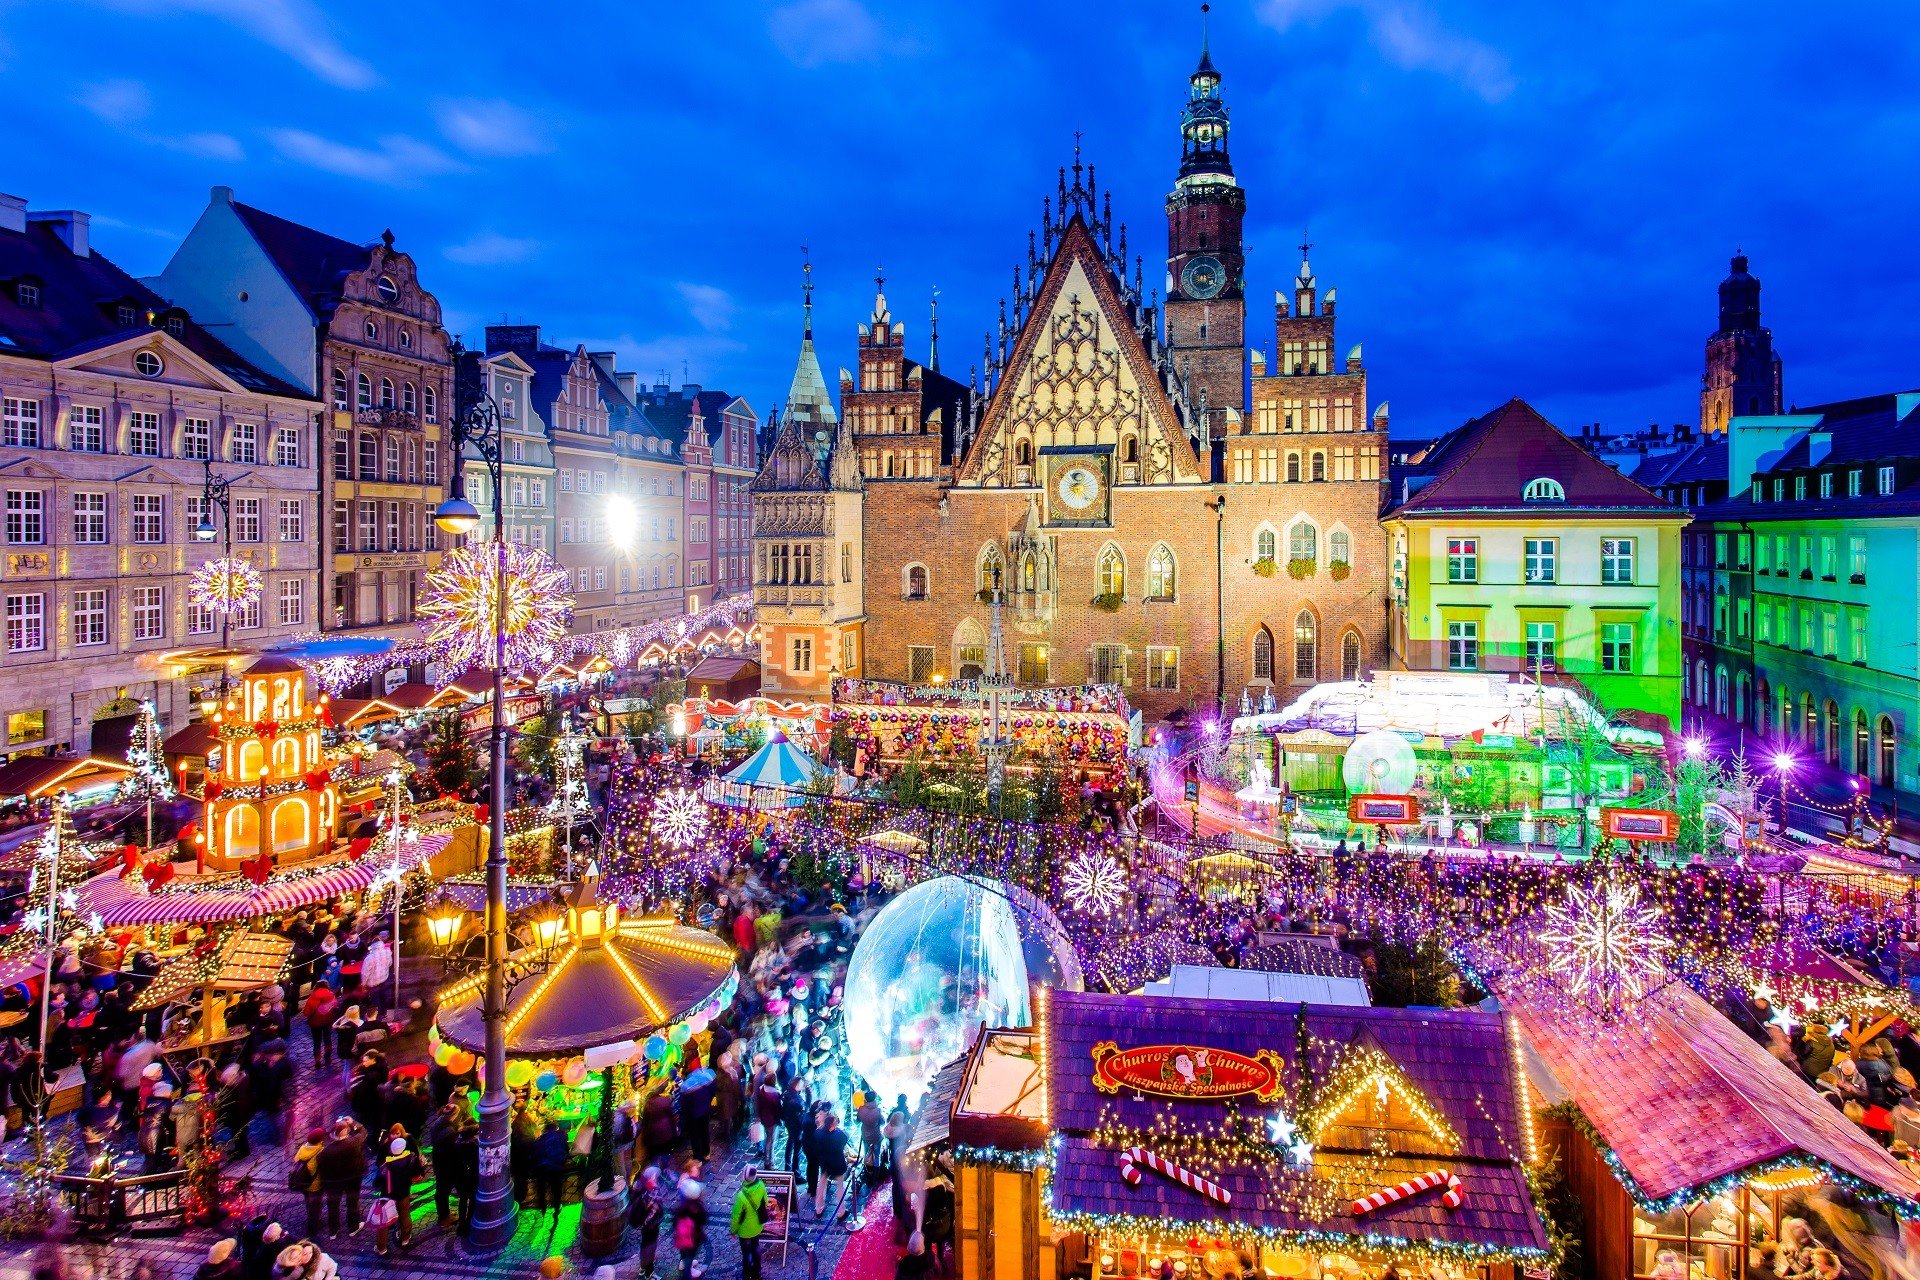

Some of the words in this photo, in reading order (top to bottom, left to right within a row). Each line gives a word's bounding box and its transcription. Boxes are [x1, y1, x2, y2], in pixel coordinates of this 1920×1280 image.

[1113, 1052, 1170, 1071] Churros
[1206, 1053, 1265, 1079] Churros
[1124, 1071, 1186, 1090] Hiszpańska
[1189, 1078, 1253, 1095] Specjalność
